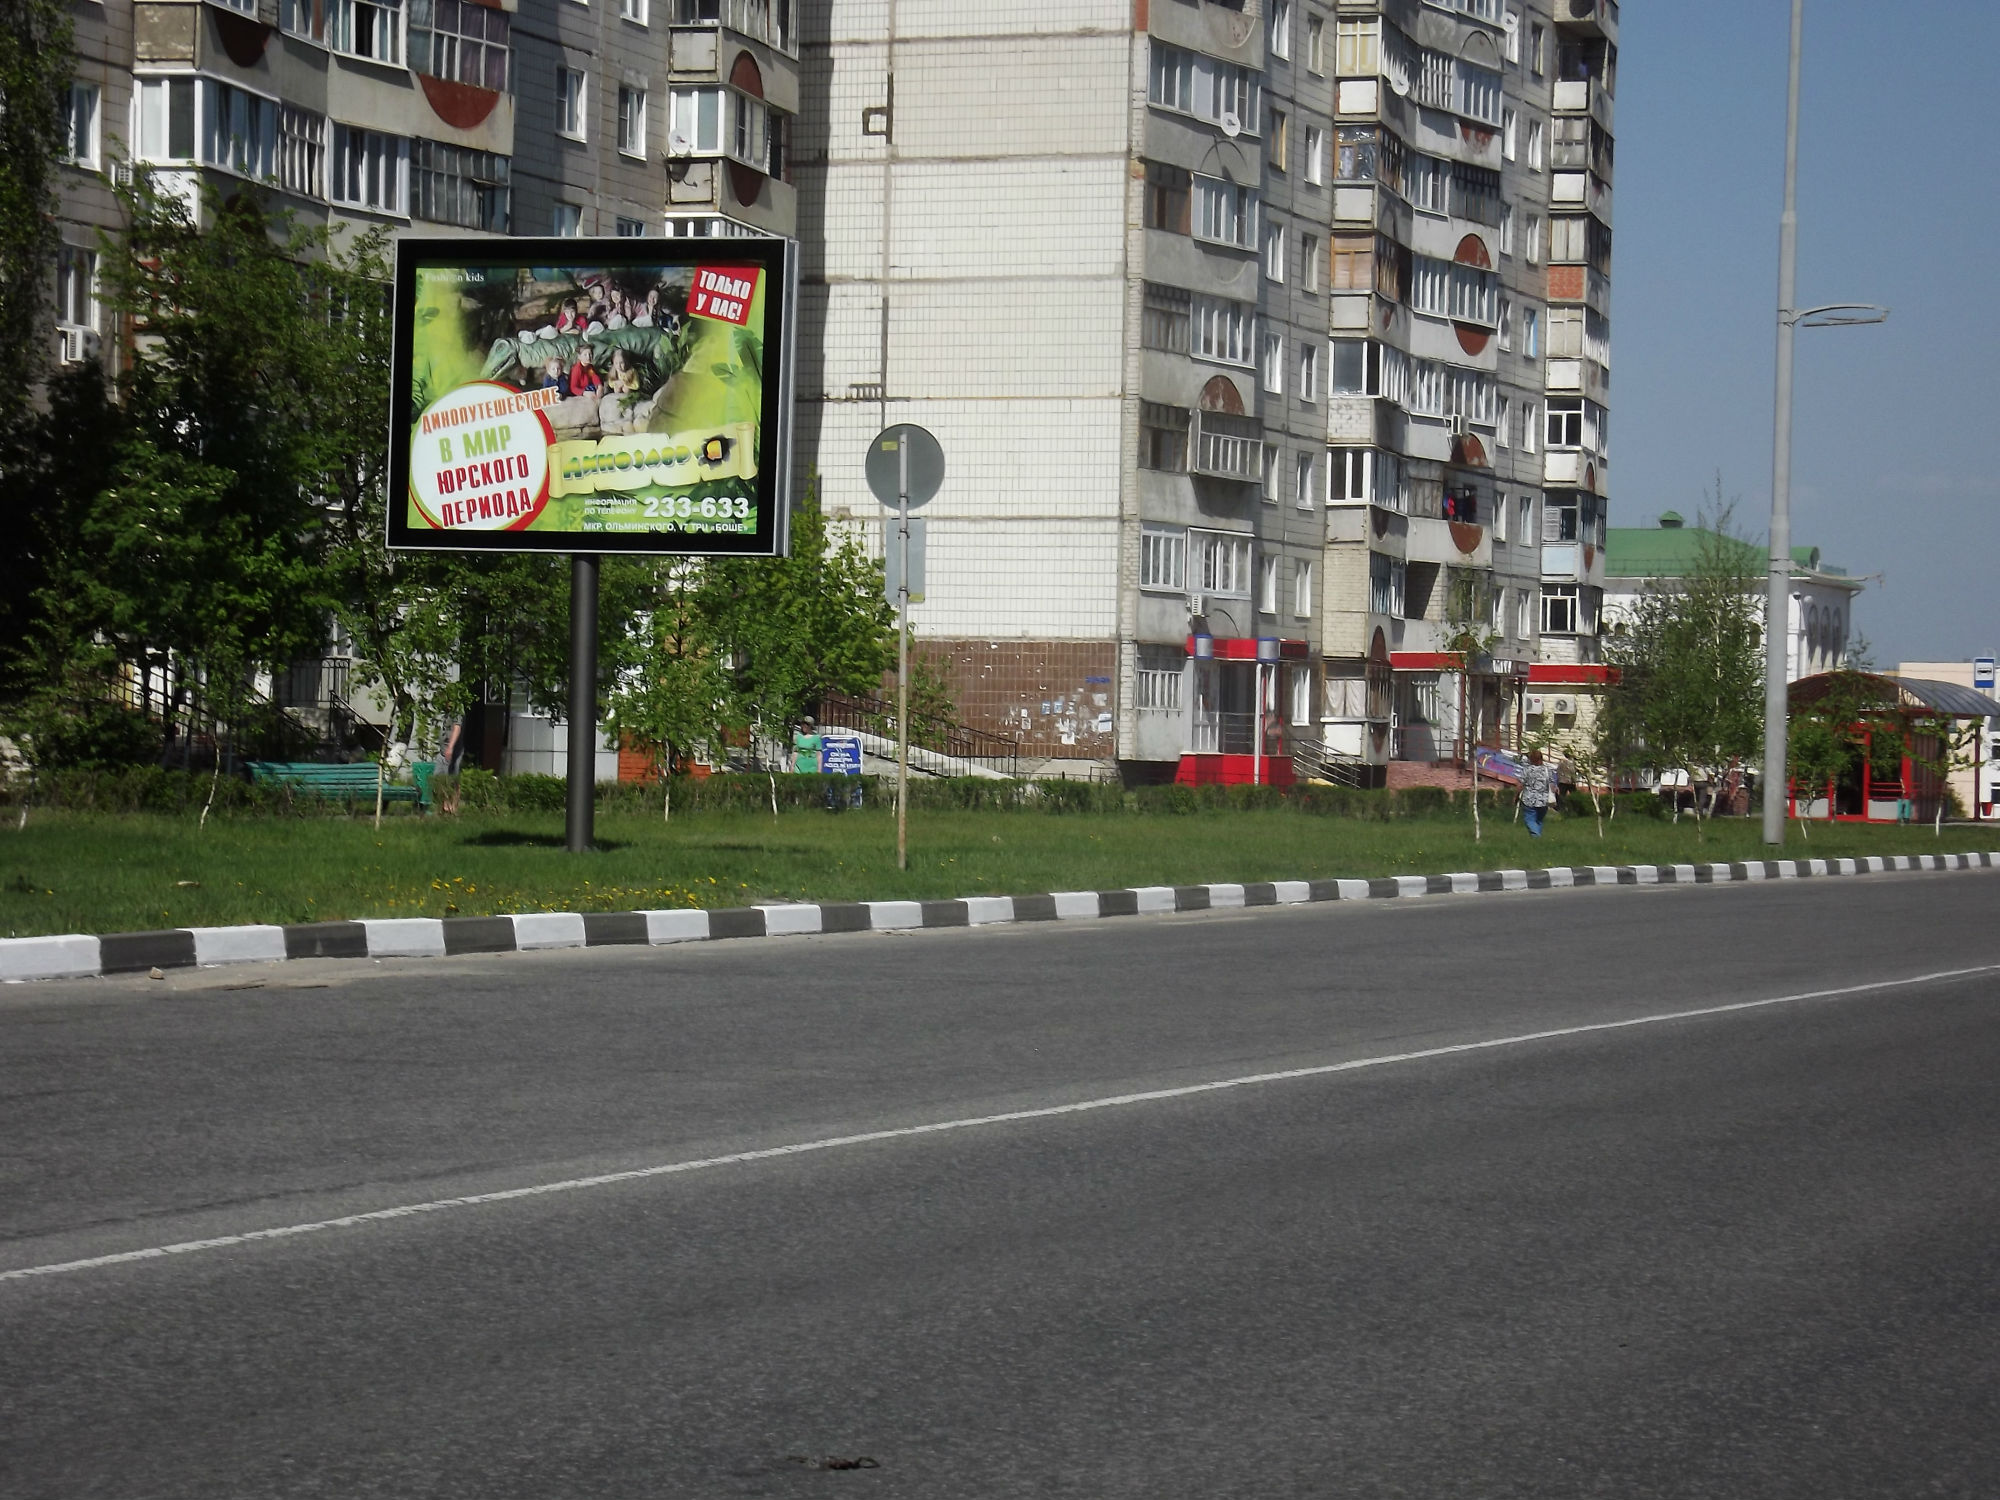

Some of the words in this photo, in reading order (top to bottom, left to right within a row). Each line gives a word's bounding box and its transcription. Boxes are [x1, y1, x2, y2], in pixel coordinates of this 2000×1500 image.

[465, 272, 485, 282] kids
[698, 270, 752, 300] ТОЛЬКО
[695, 293, 708, 311] У
[709, 296, 743, 321] НАС!
[421, 388, 558, 436] ДИНОПУТЕШЕСТВИЕ
[438, 437, 454, 463] В
[462, 424, 511, 459] МИР
[436, 454, 530, 496] ЮРСКОГО
[441, 488, 532, 528] ПЕРИОДА
[643, 497, 749, 518] 233-633
[605, 523, 676, 532] ОЛЬМИНСКОГО,
